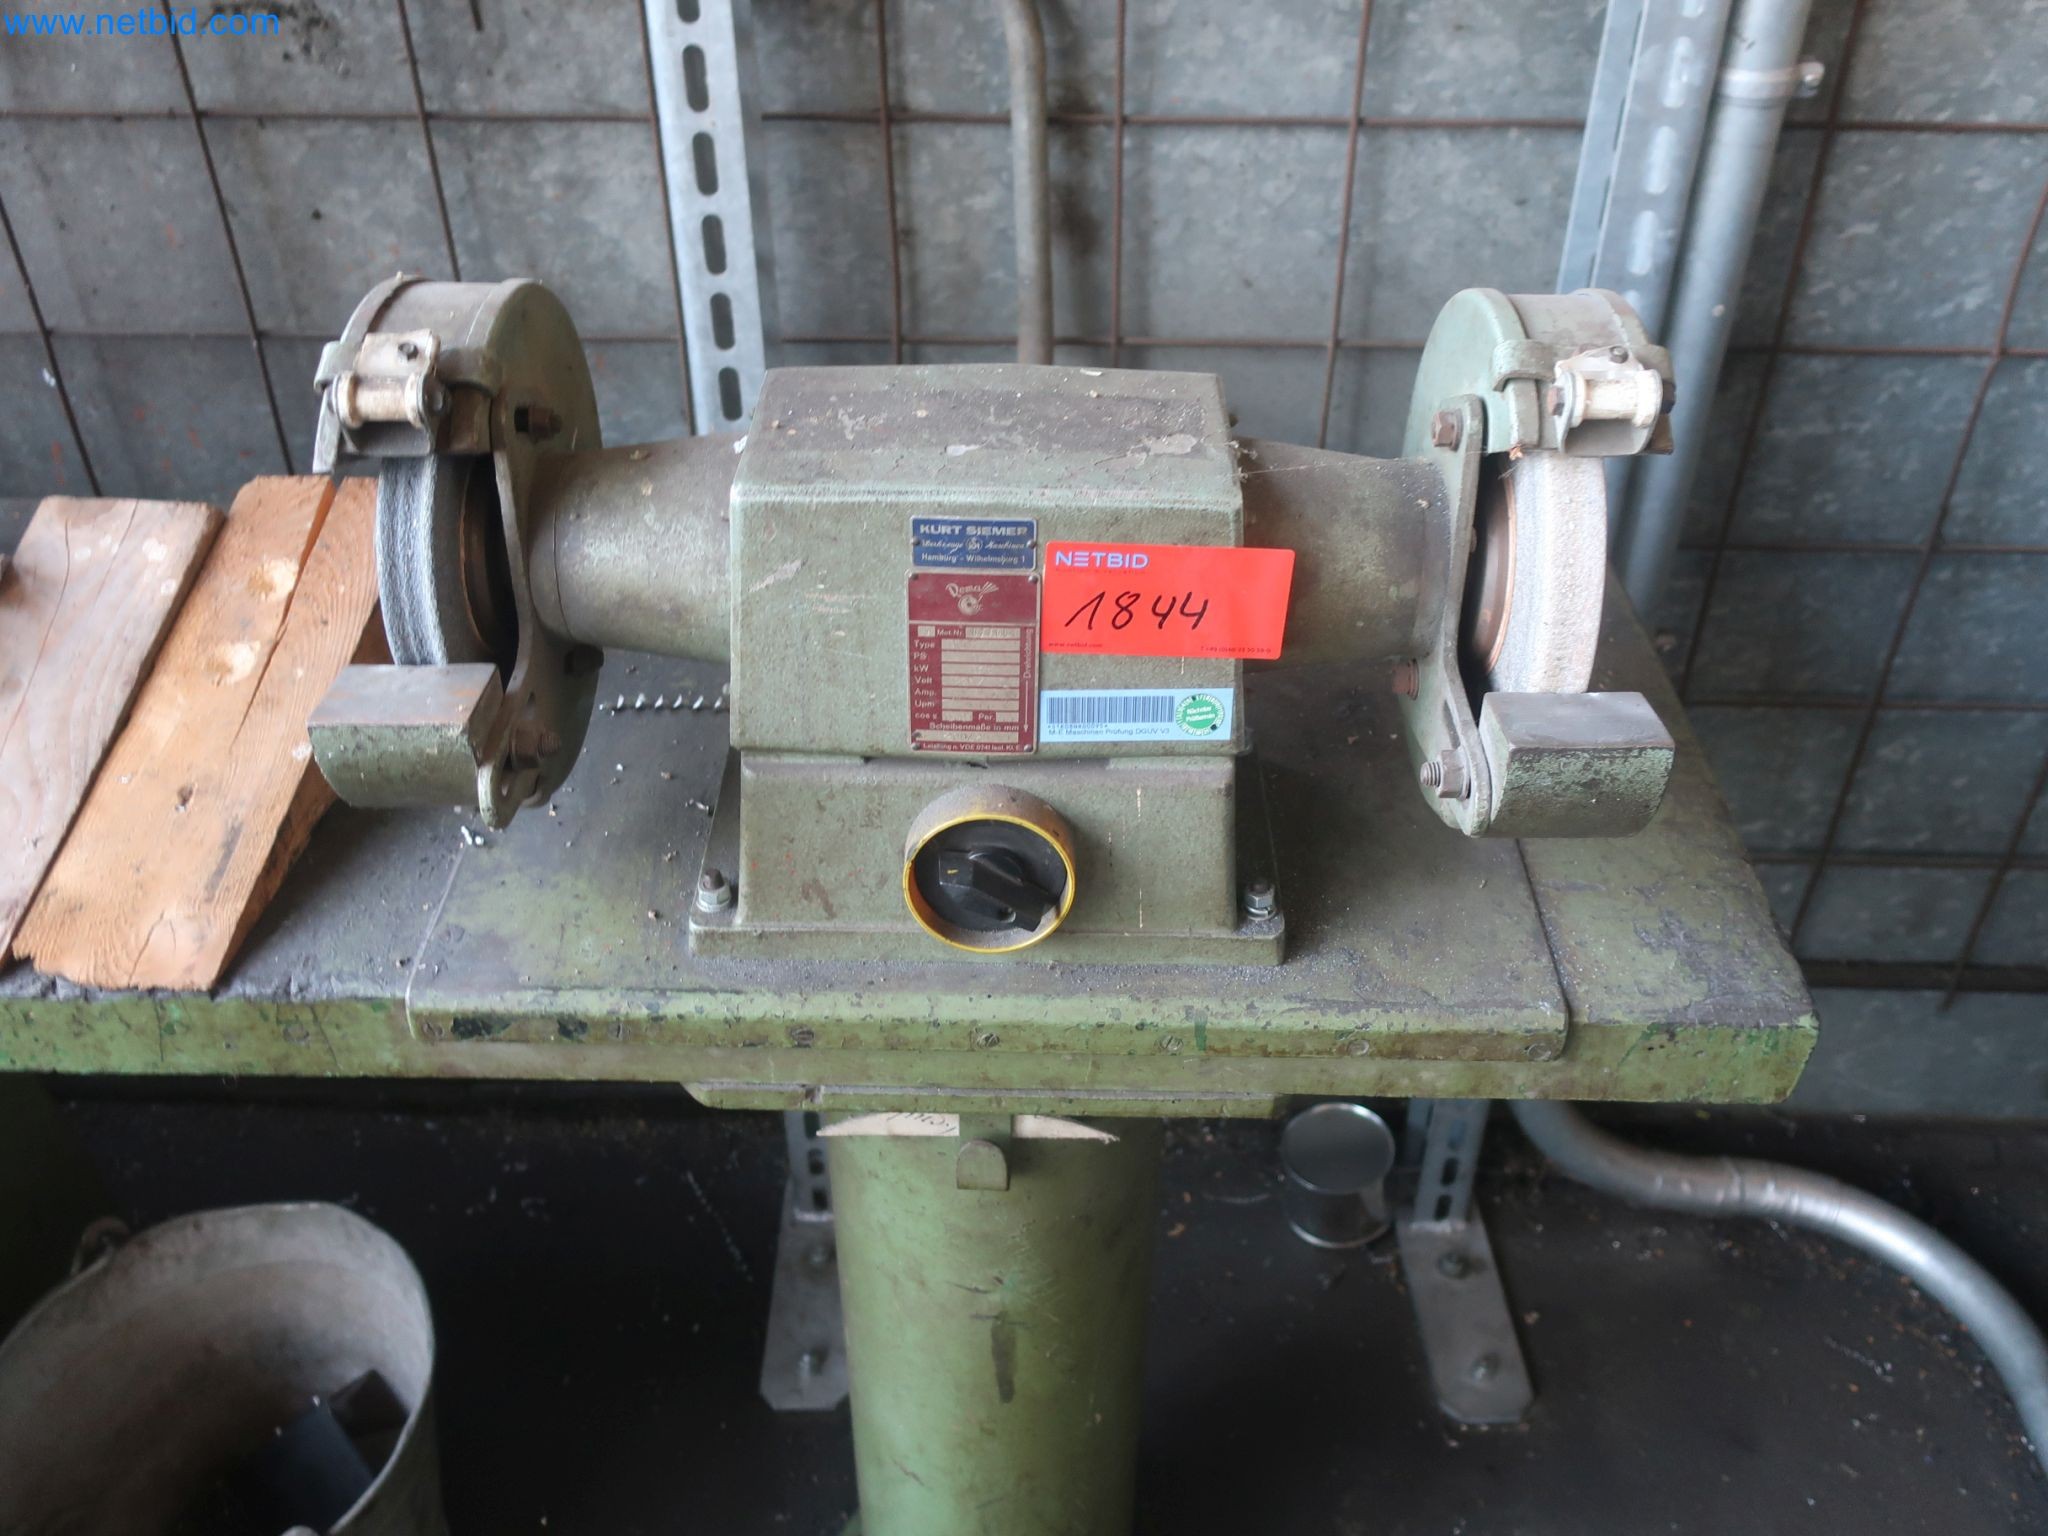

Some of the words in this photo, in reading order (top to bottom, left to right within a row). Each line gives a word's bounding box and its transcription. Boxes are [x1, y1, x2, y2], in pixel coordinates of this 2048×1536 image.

[919, 524, 963, 535] KURT
[966, 525, 1028, 537] SIEMER
[921, 553, 957, 563] Hamburg
[966, 554, 1018, 565] Wilhelmsburg
[1055, 550, 1150, 569] NETBID
[1064, 590, 1209, 631] 1844
[913, 639, 936, 649] Type
[913, 651, 927, 660] PS
[913, 664, 929, 673] kW
[914, 676, 933, 684] Volt
[914, 688, 936, 697] Amp.
[914, 700, 935, 709] Upm
[929, 722, 991, 731] Scheibenmaße
